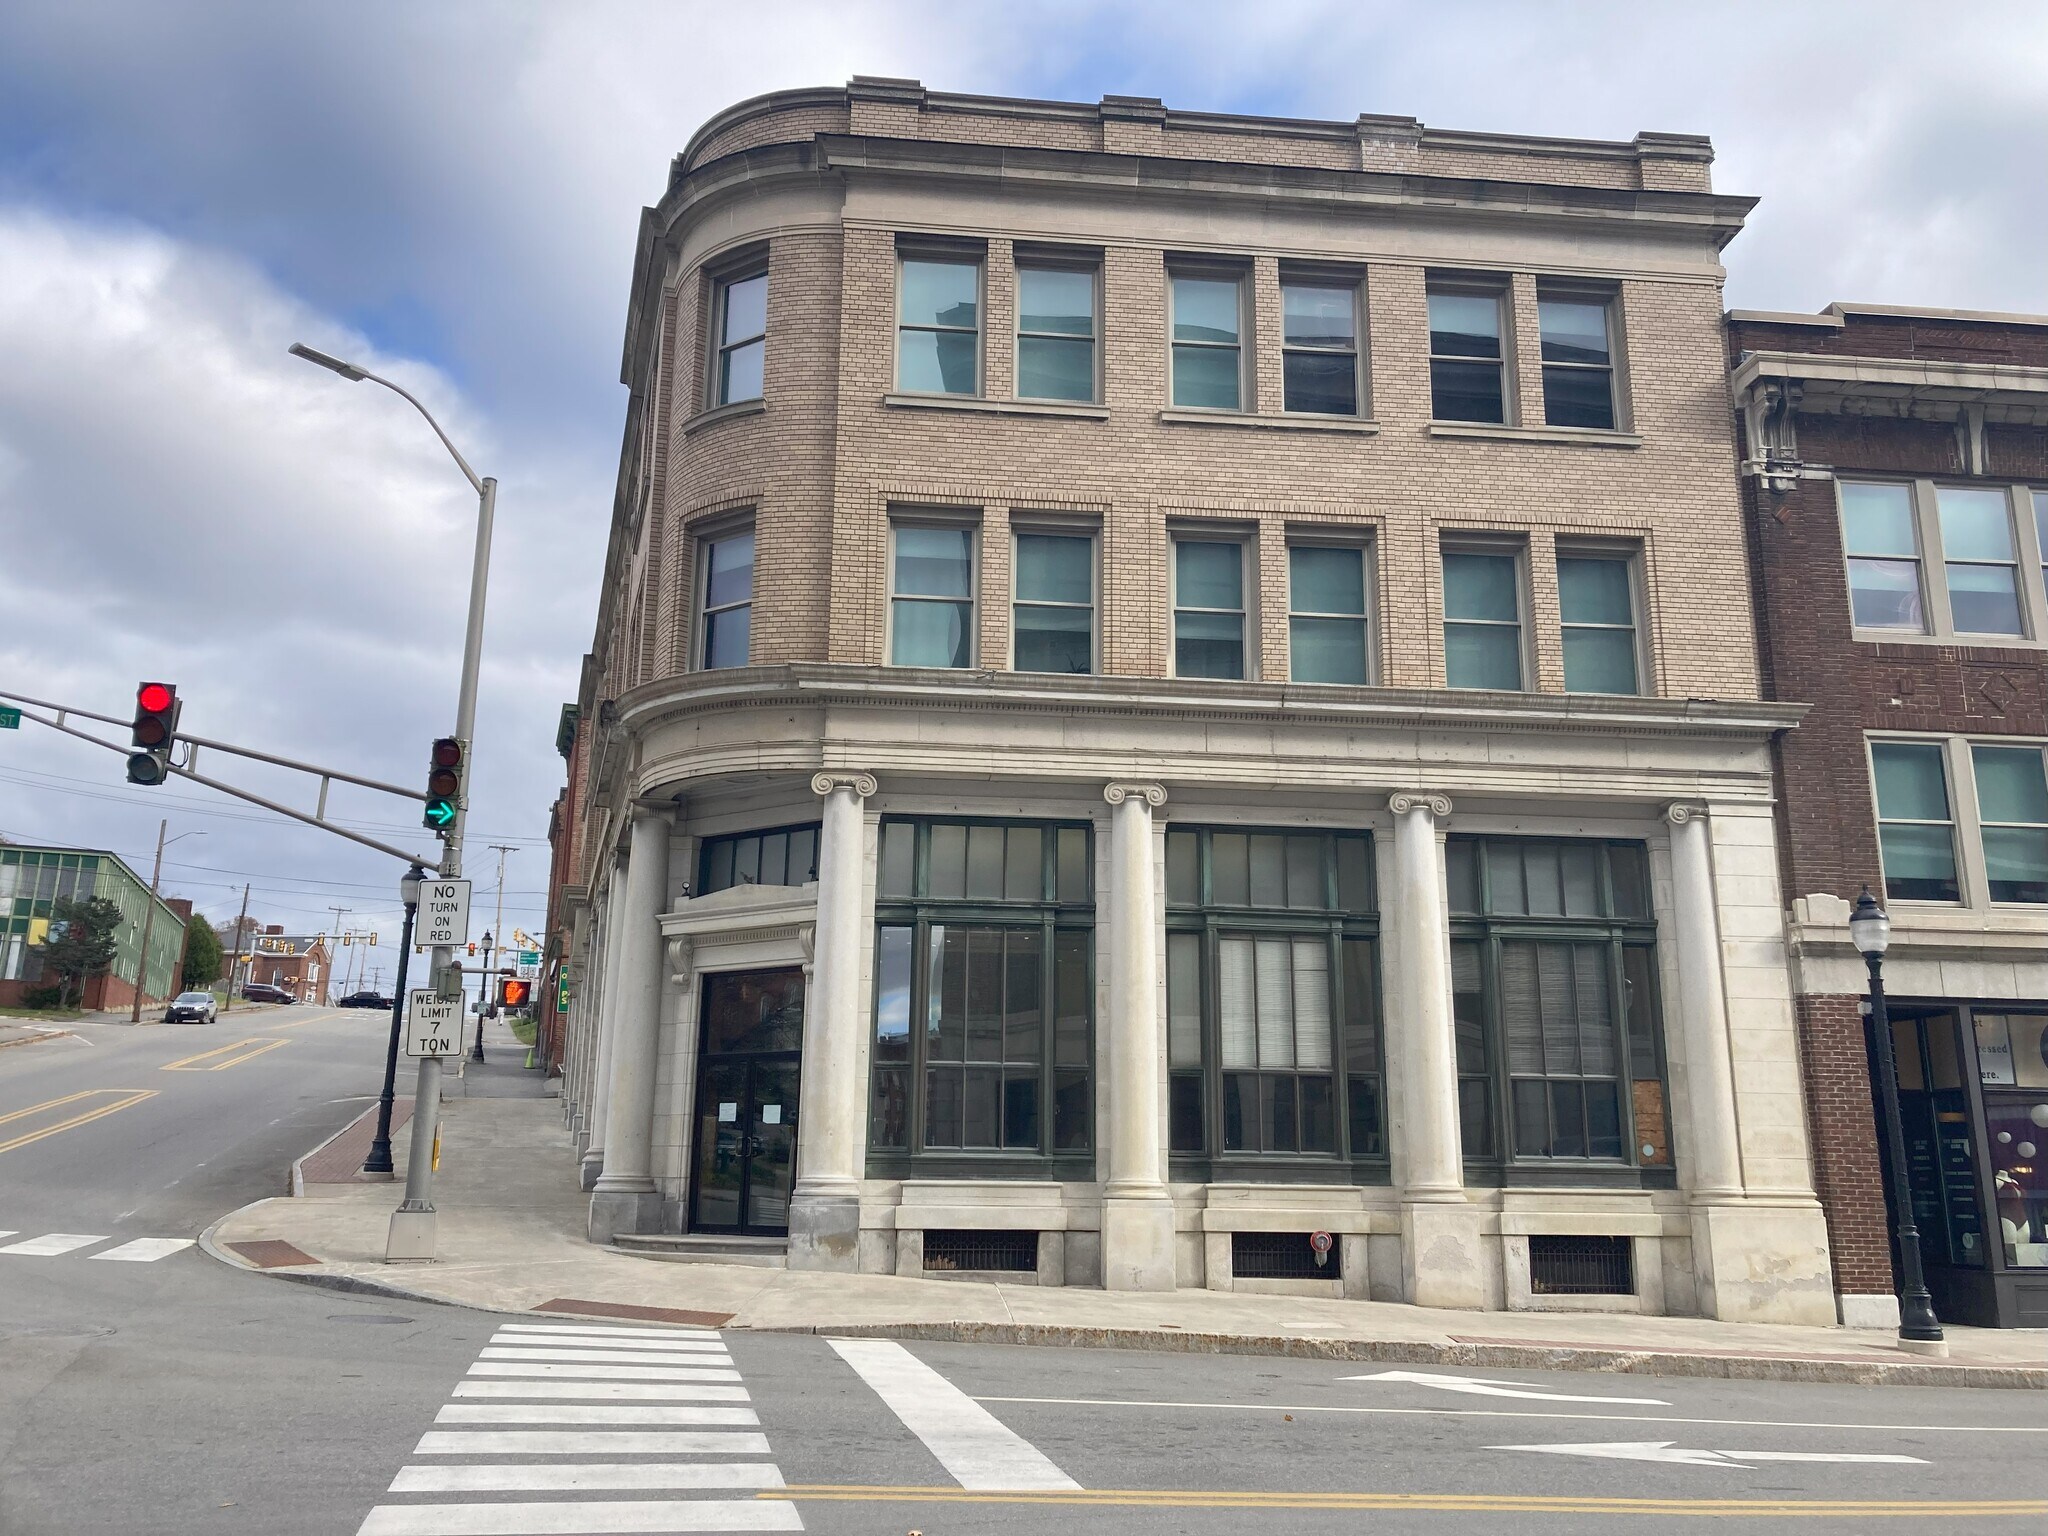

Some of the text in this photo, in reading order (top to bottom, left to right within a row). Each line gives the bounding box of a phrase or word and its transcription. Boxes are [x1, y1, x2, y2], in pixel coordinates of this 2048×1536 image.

[434, 886, 456, 898] NO
[429, 902, 458, 913] TURN
[434, 916, 450, 927] ON
[430, 930, 452, 941] RED
[415, 994, 458, 1005] WEI
[420, 1007, 452, 1018] LIMIT
[430, 1021, 441, 1035] 7
[419, 1038, 450, 1052] TON
[1977, 1043, 2008, 1054] ressed
[1980, 1071, 2000, 1079] ere.
